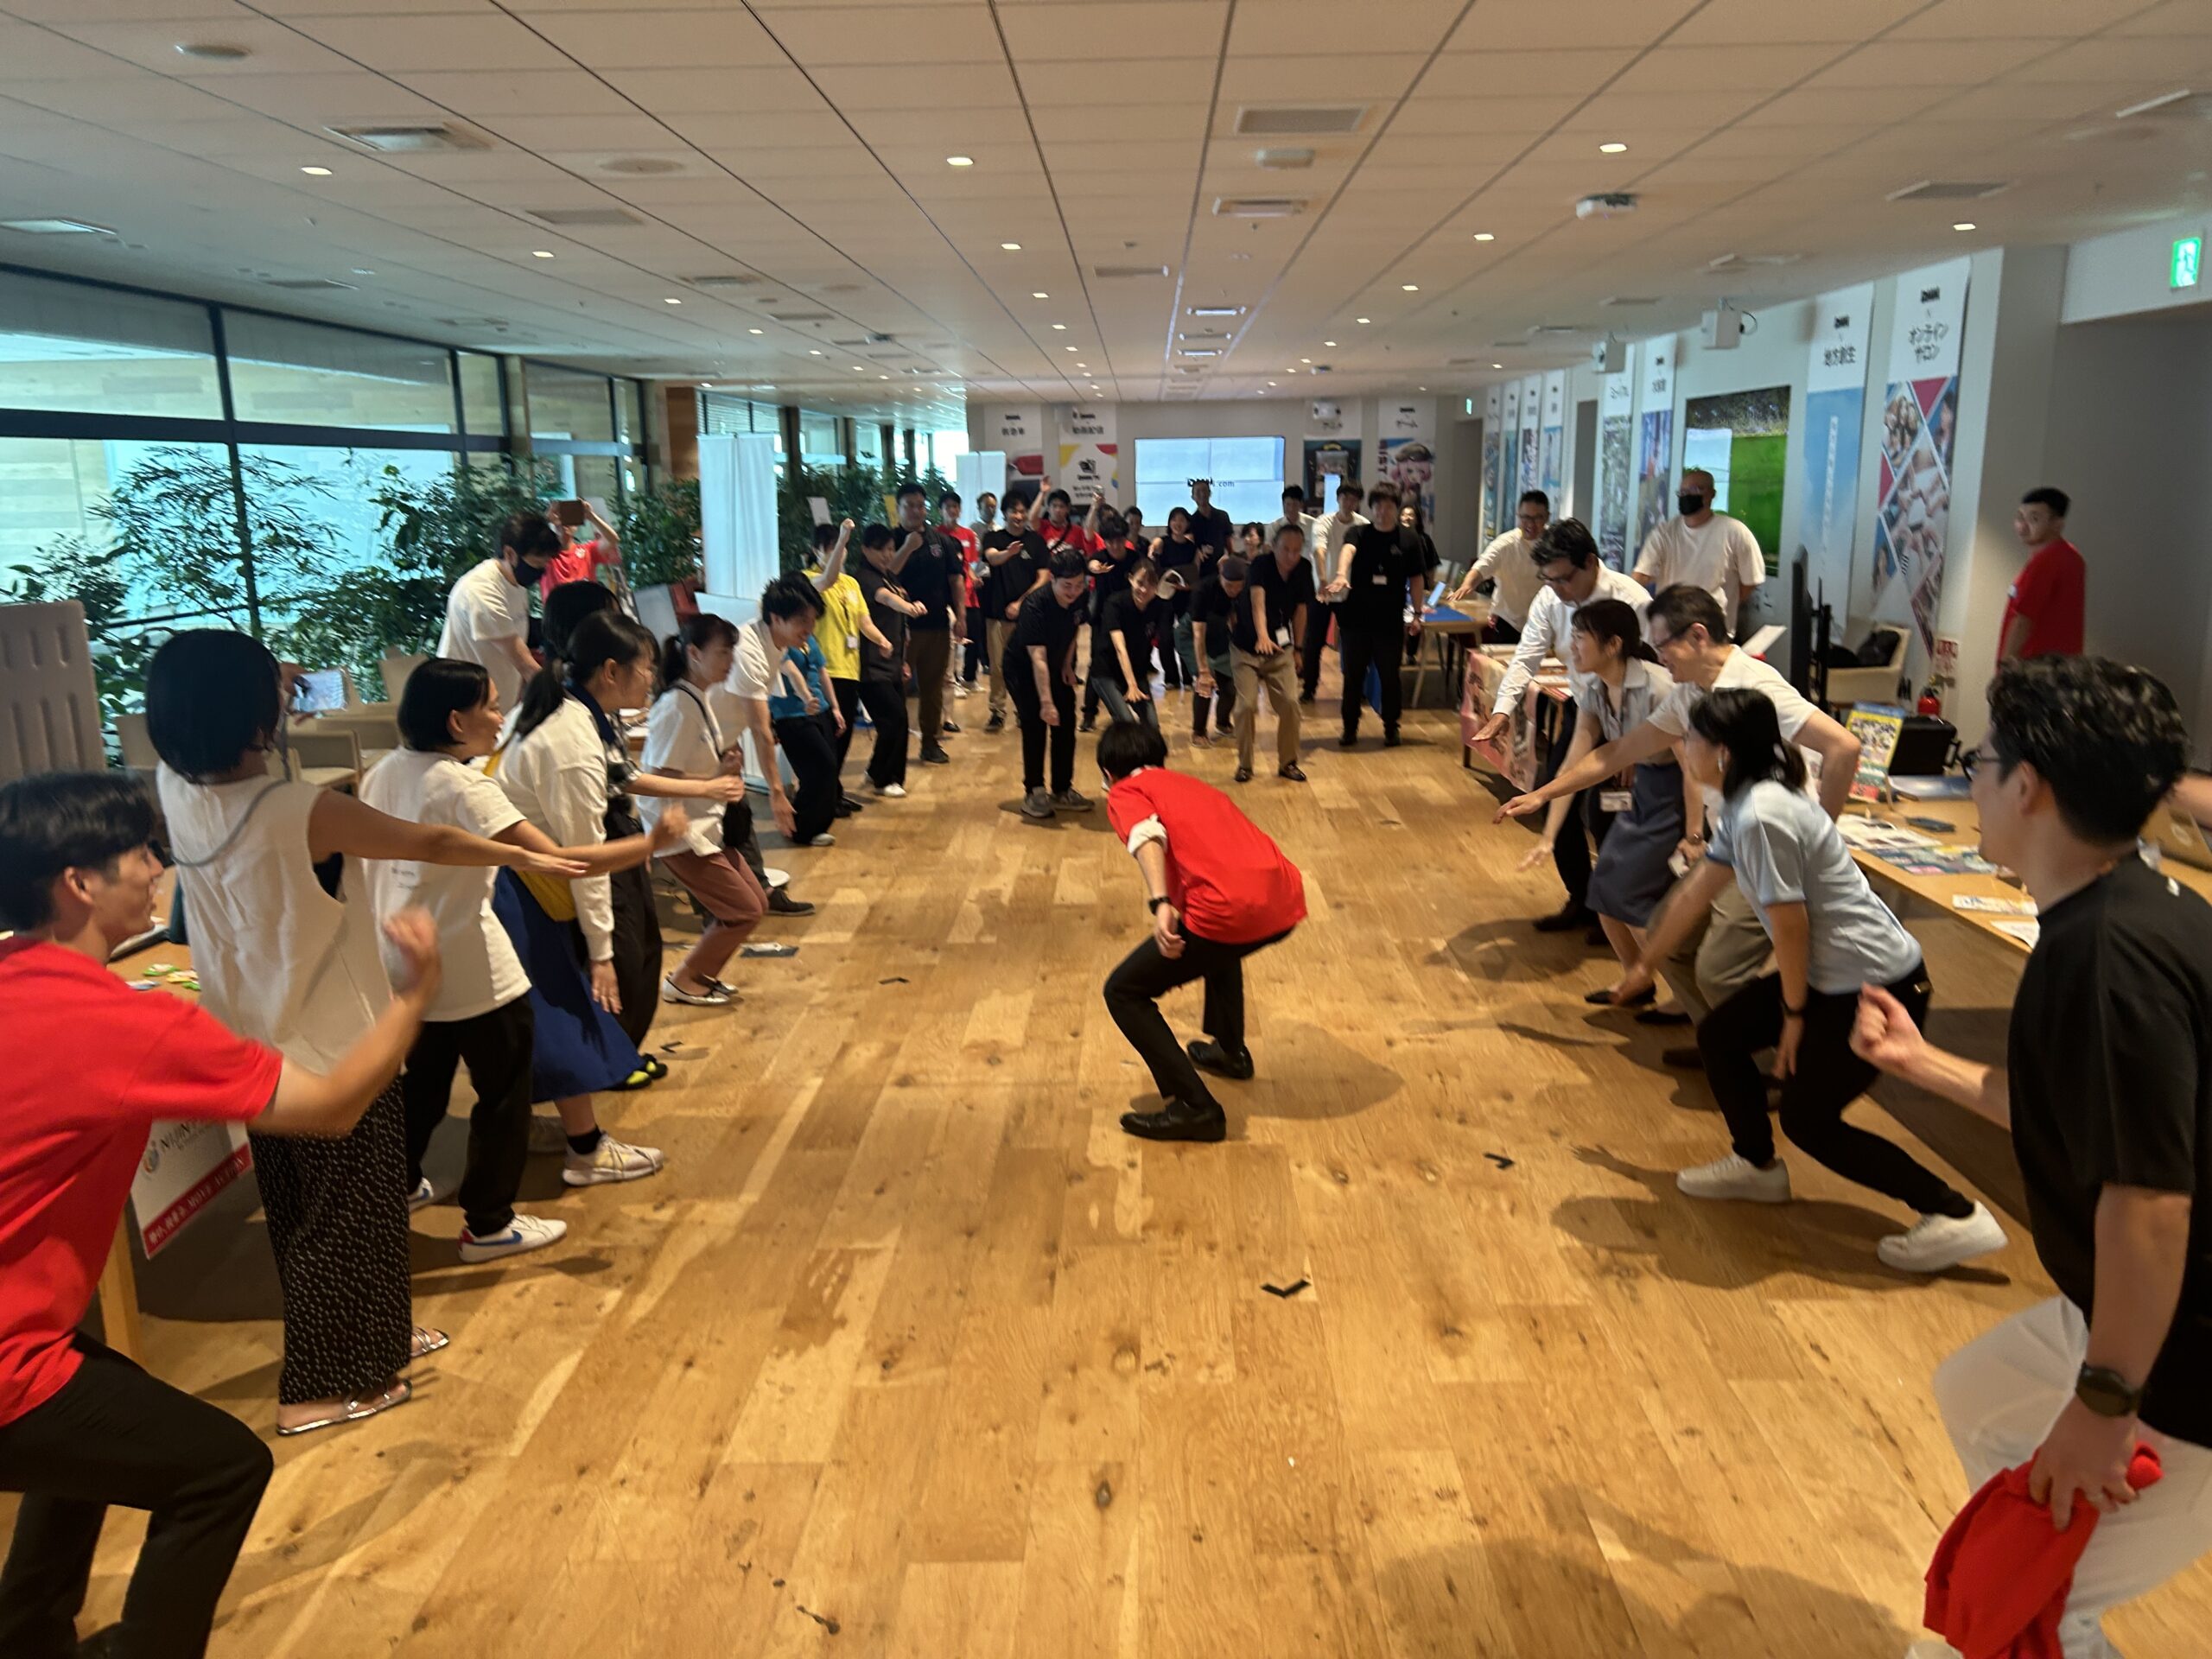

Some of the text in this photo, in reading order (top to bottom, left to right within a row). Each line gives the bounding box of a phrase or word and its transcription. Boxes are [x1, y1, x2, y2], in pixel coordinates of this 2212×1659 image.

[1908, 321, 1949, 345] オンライン
